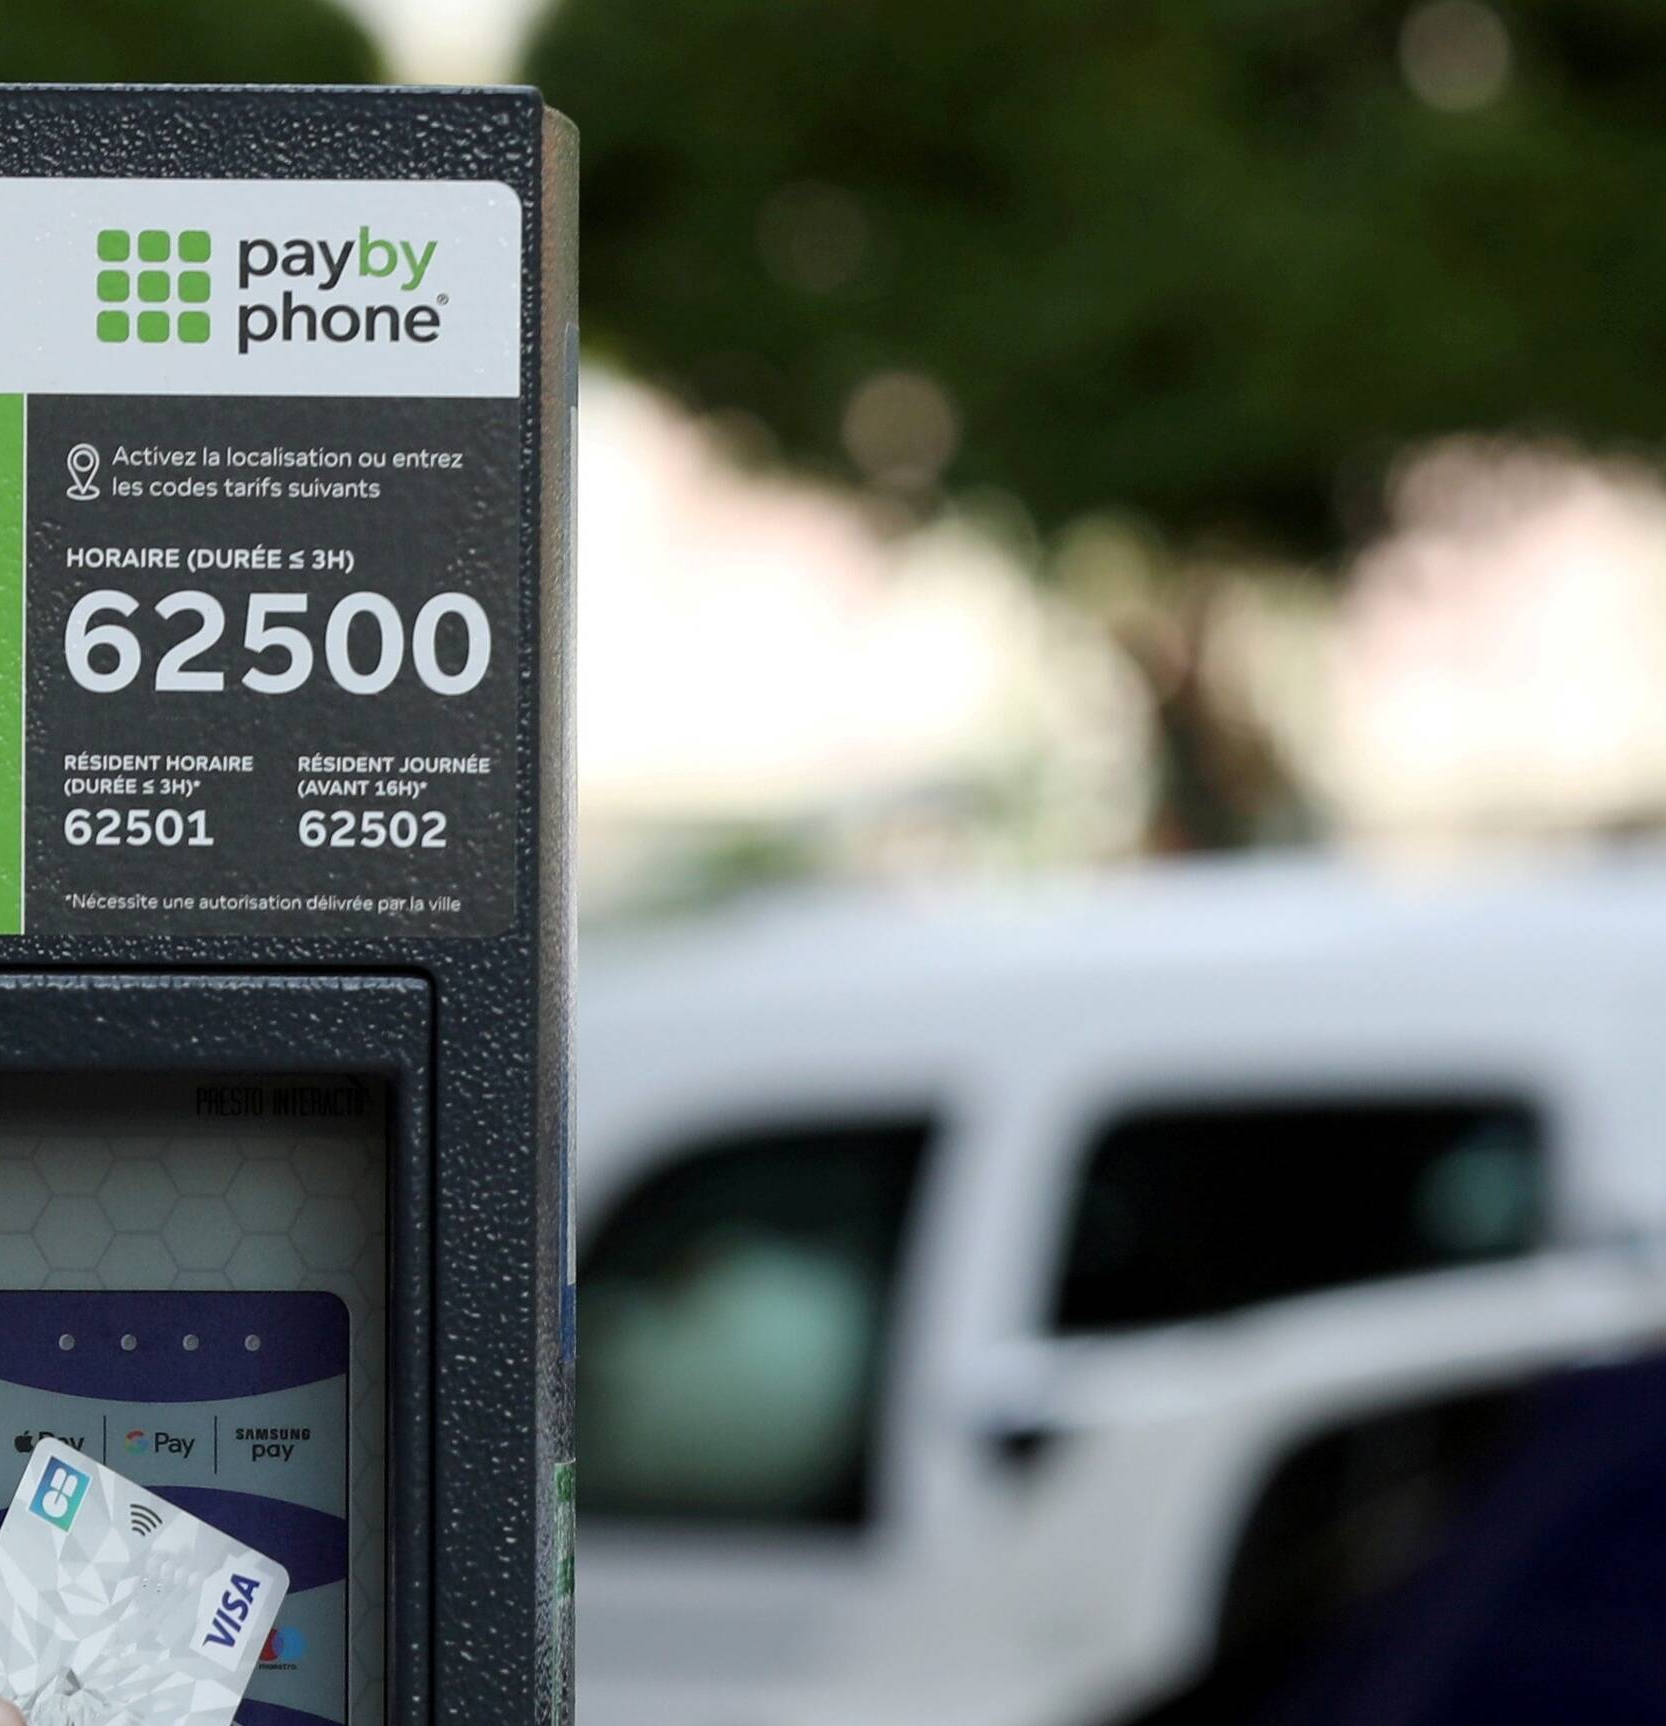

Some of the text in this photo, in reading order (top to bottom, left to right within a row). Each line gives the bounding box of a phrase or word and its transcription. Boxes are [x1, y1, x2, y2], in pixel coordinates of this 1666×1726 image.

[239, 226, 438, 291] payby
[112, 446, 464, 469] Activez la localisation ou entrez
[112, 477, 381, 499] les codes tarifs suivants
[66, 543, 354, 574] HORAIRE (DURÉE ≤ 3H)
[64, 590, 491, 696] 62500
[64, 750, 253, 772] RÉSIDENT HORAIRE
[298, 752, 491, 774] RÉSIDENT JOURNÉE
[64, 776, 137, 797] (DURÉE
[142, 781, 155, 795] ≤
[298, 779, 369, 798] (AVANT
[64, 809, 214, 847] 62501
[298, 810, 448, 848] 62502
[162, 897, 194, 911] une
[199, 894, 301, 912] autorisation
[306, 895, 373, 912] délivrée
[378, 899, 406, 916] par
[409, 897, 424, 912] la
[428, 896, 461, 913] ville
[196, 1086, 263, 1115] PRESTO
[155, 1432, 195, 1459] Pay
[235, 1428, 311, 1441] SAMSUNG
[252, 1443, 295, 1462] pay
[202, 1573, 261, 1649] VISA
